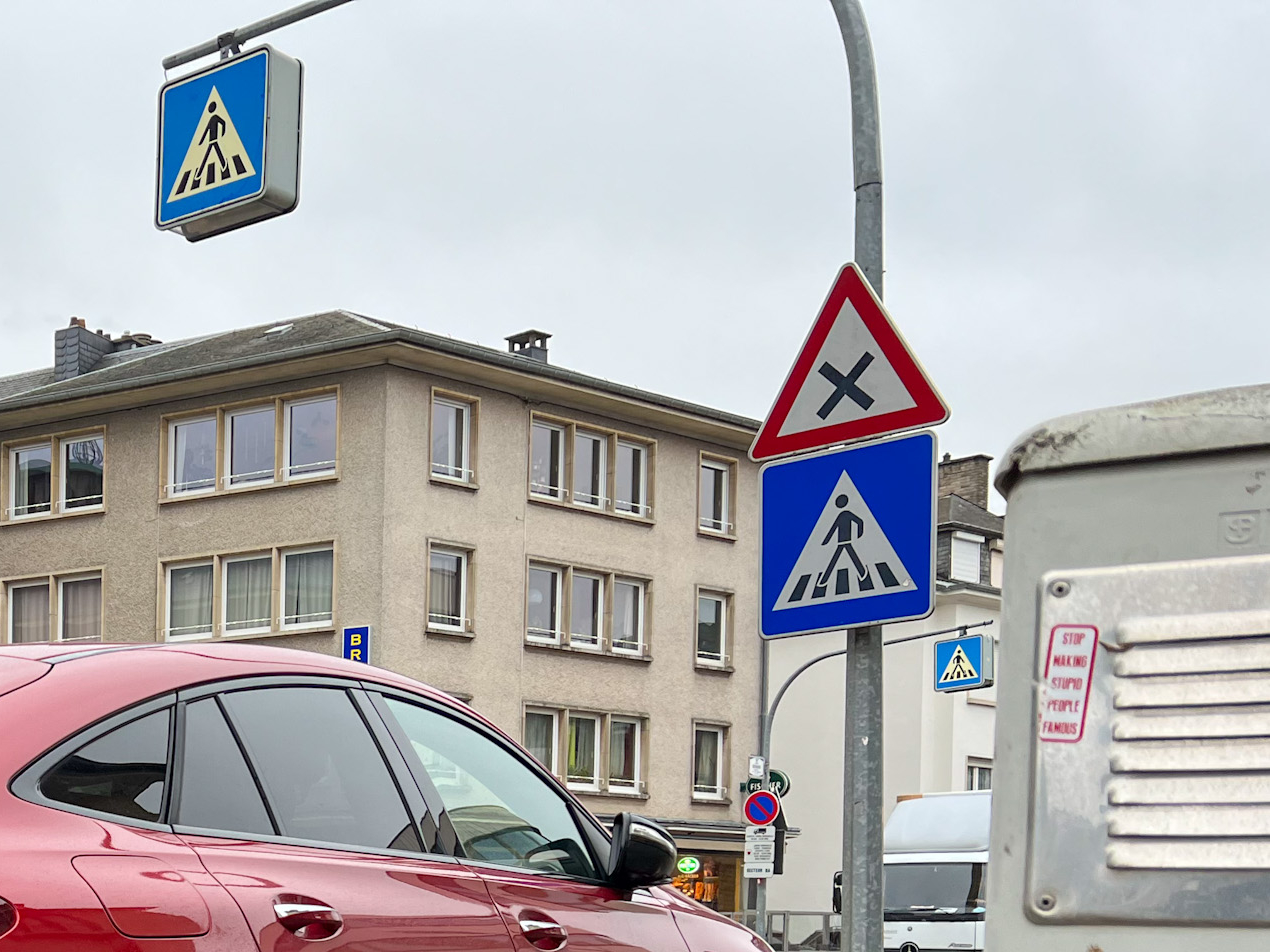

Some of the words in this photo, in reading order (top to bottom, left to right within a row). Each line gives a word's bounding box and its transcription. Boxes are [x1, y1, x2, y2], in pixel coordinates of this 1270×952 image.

[1062, 632, 1085, 646] STOP
[1052, 655, 1088, 668] MAKING
[1051, 677, 1083, 690] STUPID
[1047, 700, 1080, 713] PEOPLE
[1042, 721, 1078, 735] FAMOUS
[750, 781, 781, 791] FISER
